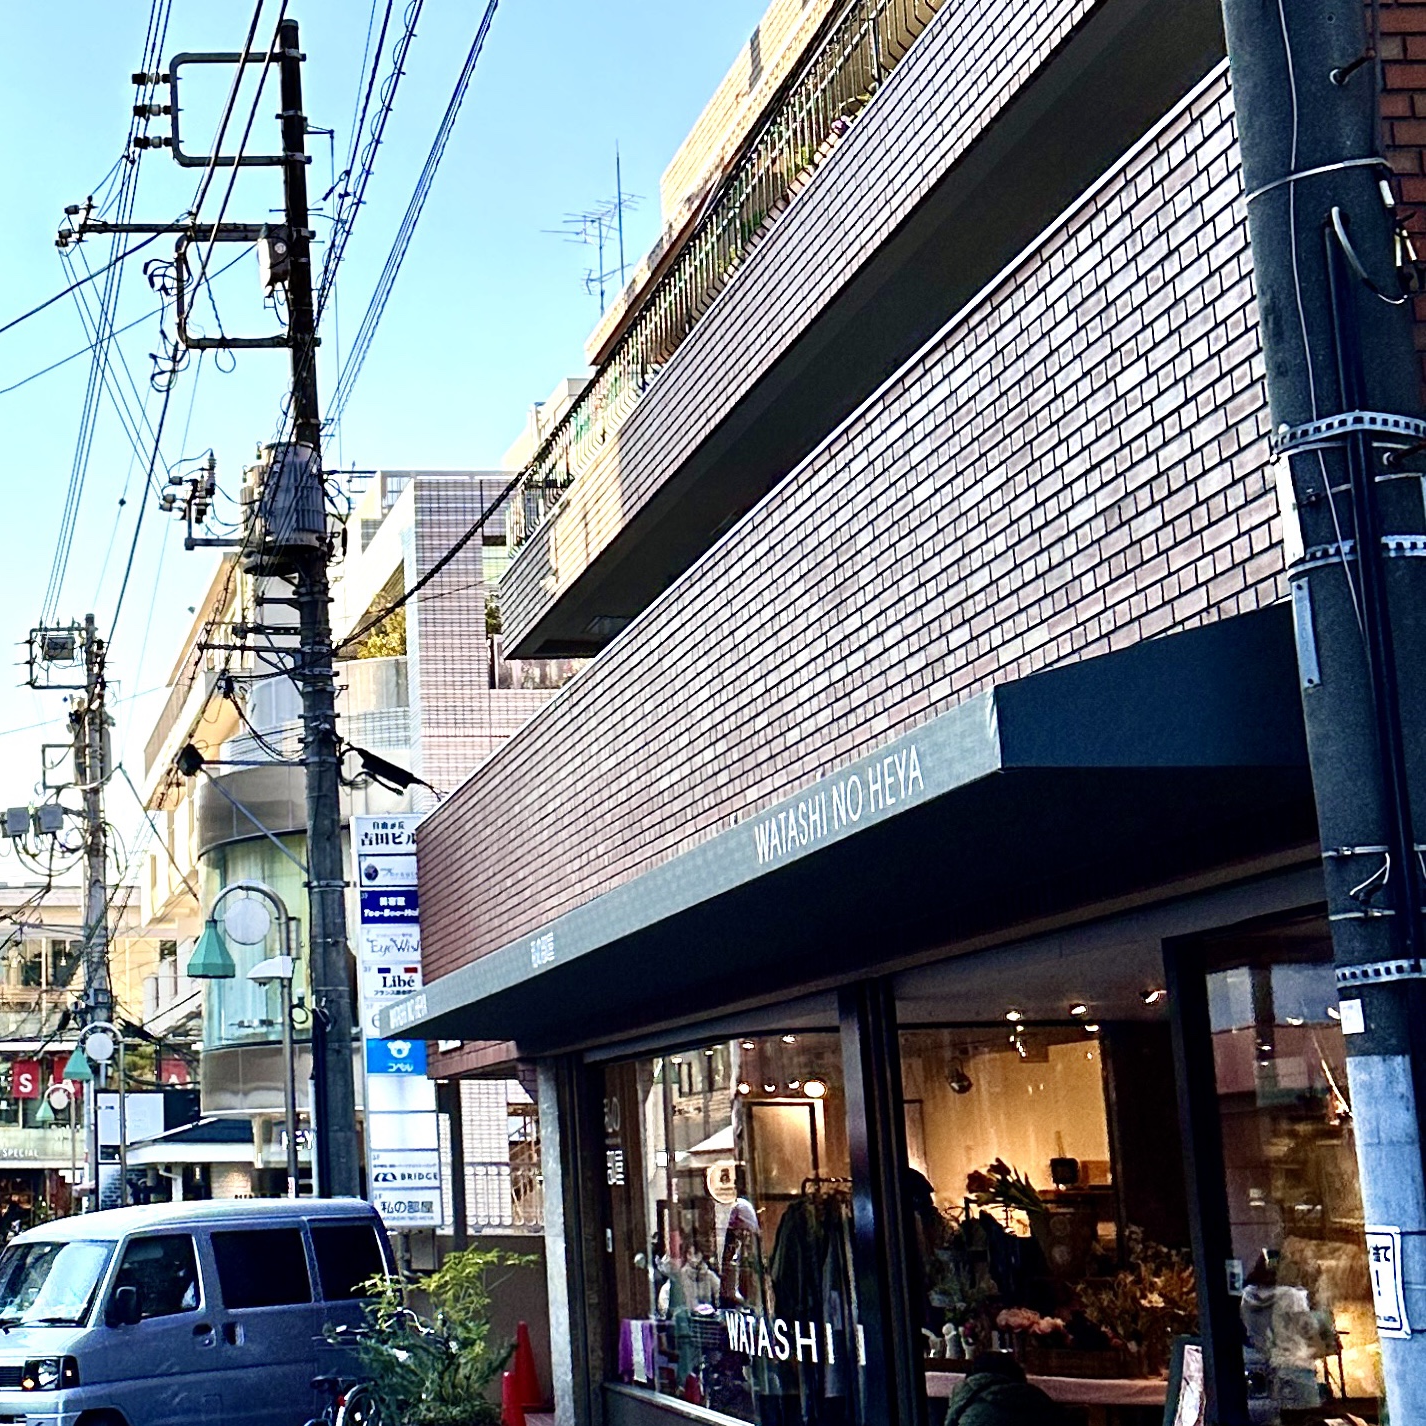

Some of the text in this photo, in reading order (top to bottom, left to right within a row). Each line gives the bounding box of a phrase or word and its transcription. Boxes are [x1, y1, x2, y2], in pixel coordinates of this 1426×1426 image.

[755, 745, 924, 864] WATASHI NO HEYA
[382, 975, 416, 988] Libé
[19, 1073, 33, 1093] S
[2, 1148, 39, 1158] SPECIAL
[400, 1172, 438, 1181] BRIDGE
[725, 1310, 835, 1365] WATASHI
